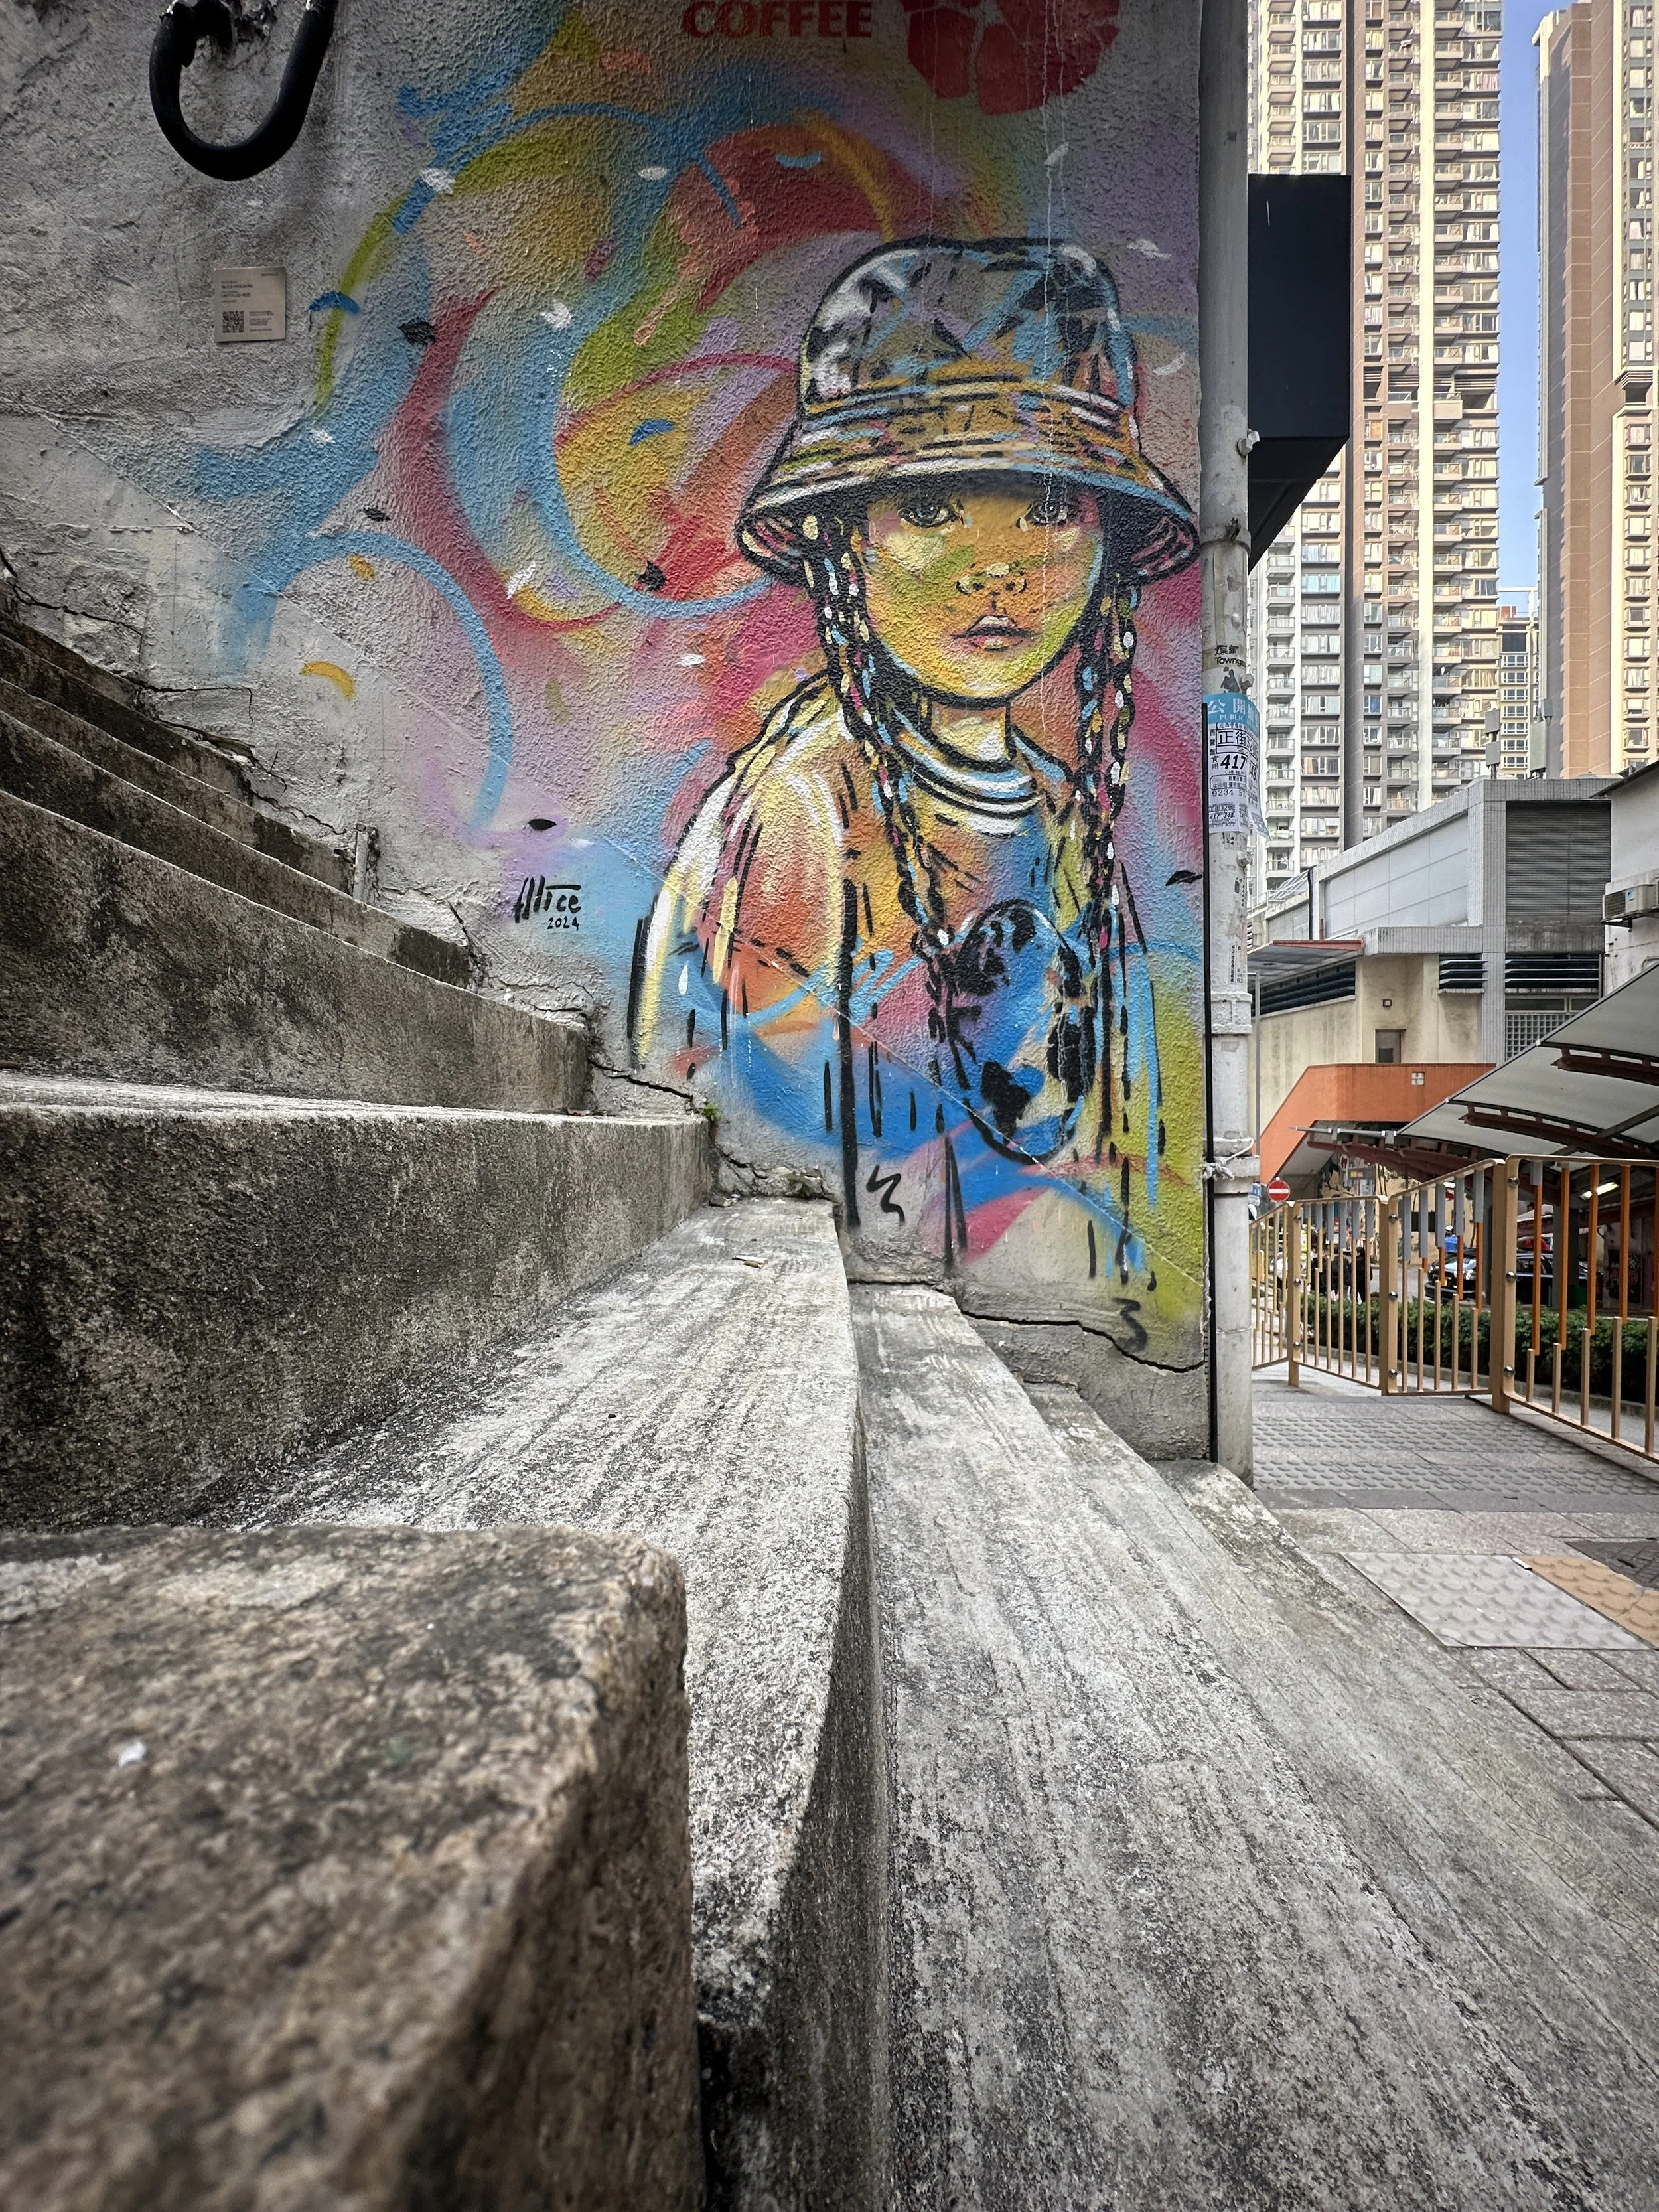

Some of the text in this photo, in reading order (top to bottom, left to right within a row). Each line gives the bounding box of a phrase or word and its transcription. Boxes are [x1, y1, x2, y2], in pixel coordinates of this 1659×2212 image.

[682, 1, 872, 38] COFFEE
[1220, 754, 1246, 770] 417
[547, 917, 580, 931] 2024
